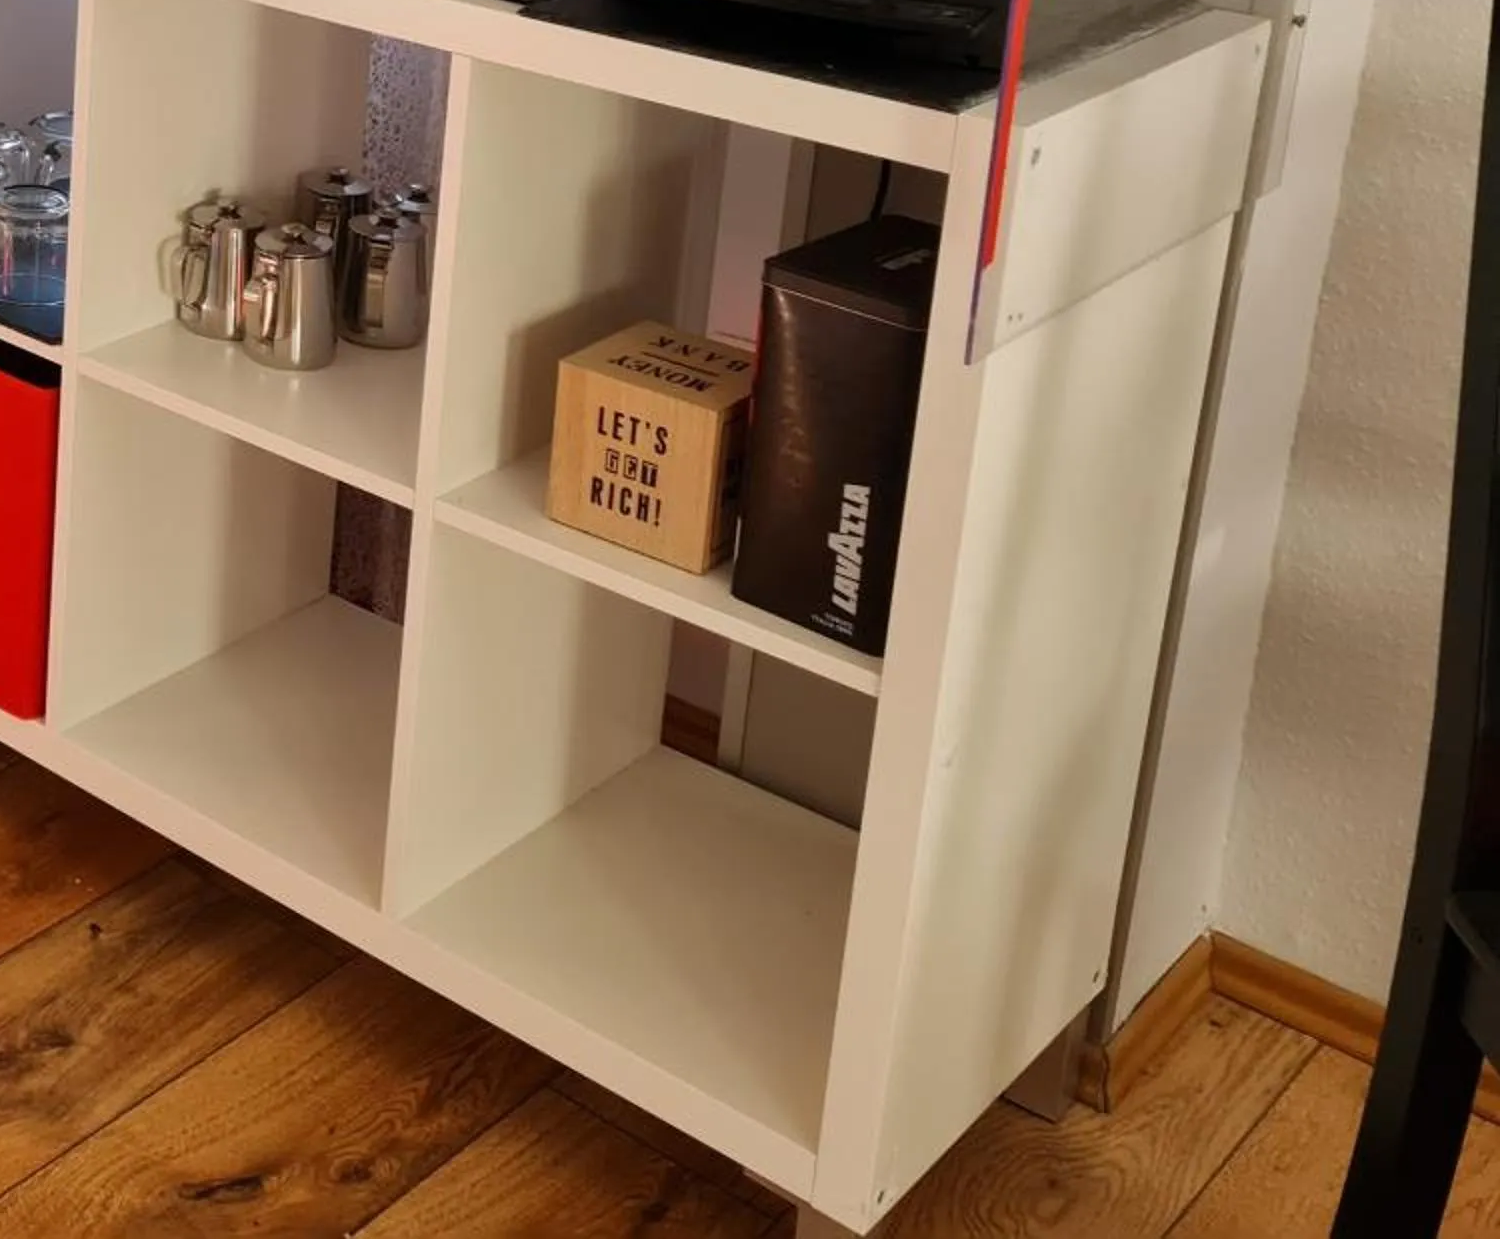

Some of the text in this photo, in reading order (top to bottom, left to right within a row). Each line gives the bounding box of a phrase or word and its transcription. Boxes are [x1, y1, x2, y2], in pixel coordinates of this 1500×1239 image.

[606, 354, 714, 393] MONEY
[646, 334, 751, 373] BANK
[597, 406, 670, 456] LET'S
[604, 447, 660, 489] GET
[589, 475, 663, 528] RICH!
[826, 482, 872, 617] LAVAZZA
